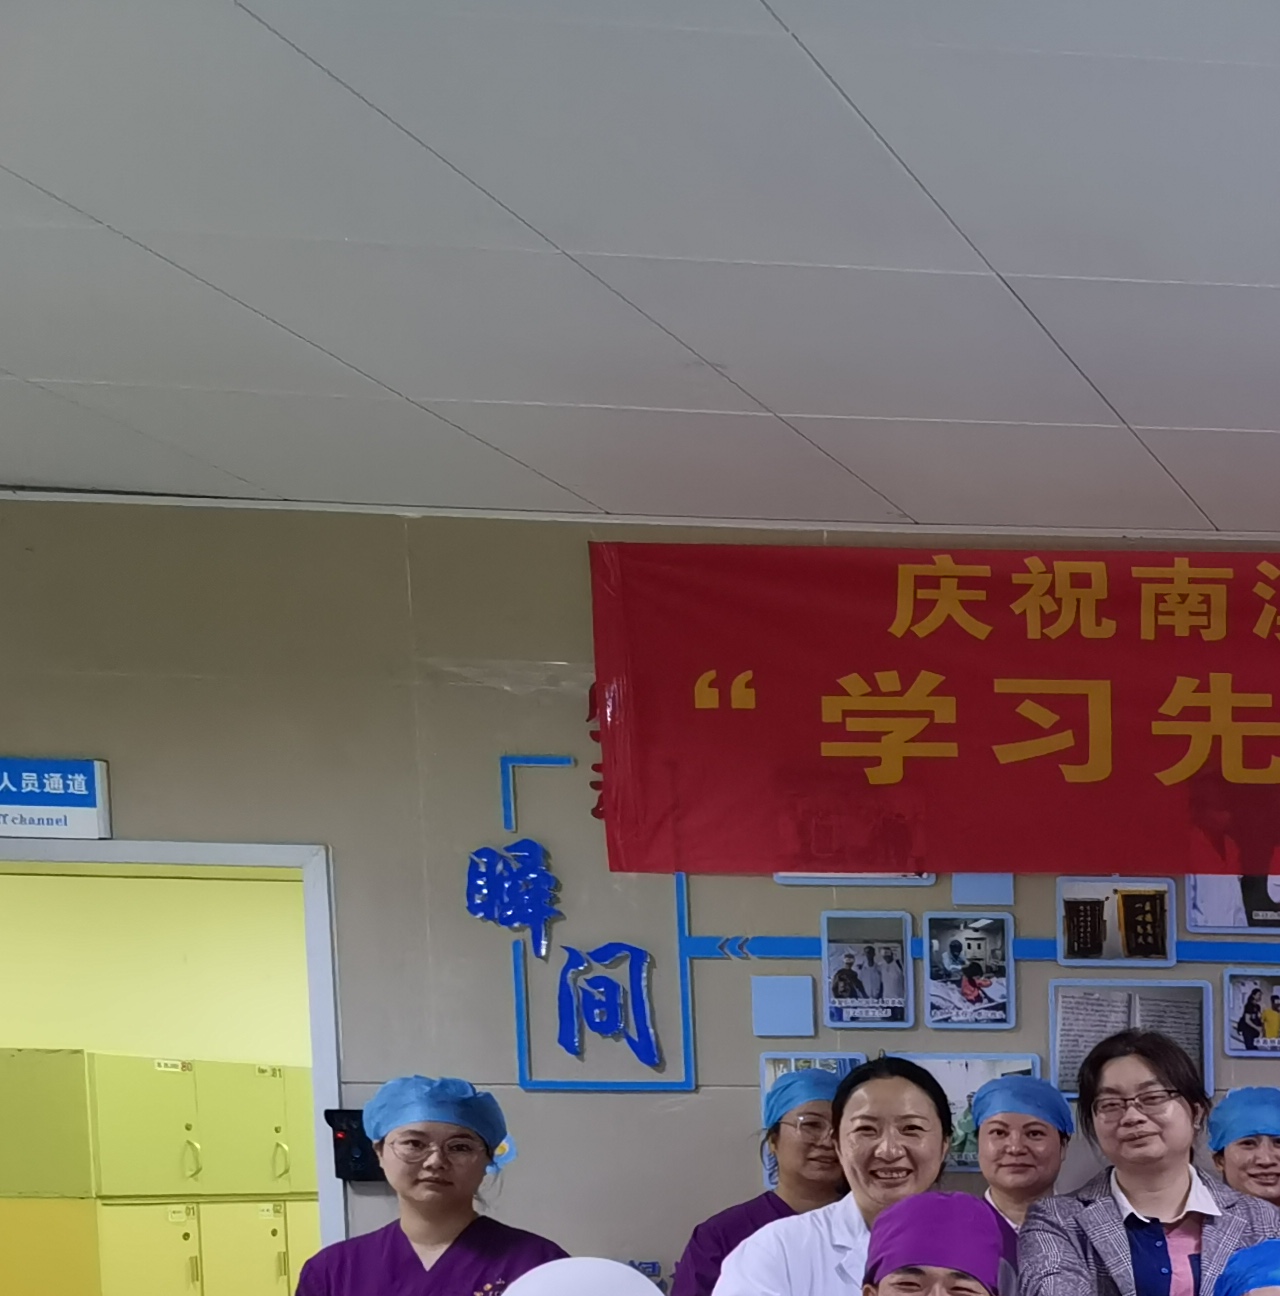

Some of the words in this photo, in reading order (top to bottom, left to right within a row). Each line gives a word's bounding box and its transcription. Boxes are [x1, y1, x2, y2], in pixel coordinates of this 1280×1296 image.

[0, 772, 89, 794] 人员通道
[11, 814, 68, 826] channel
